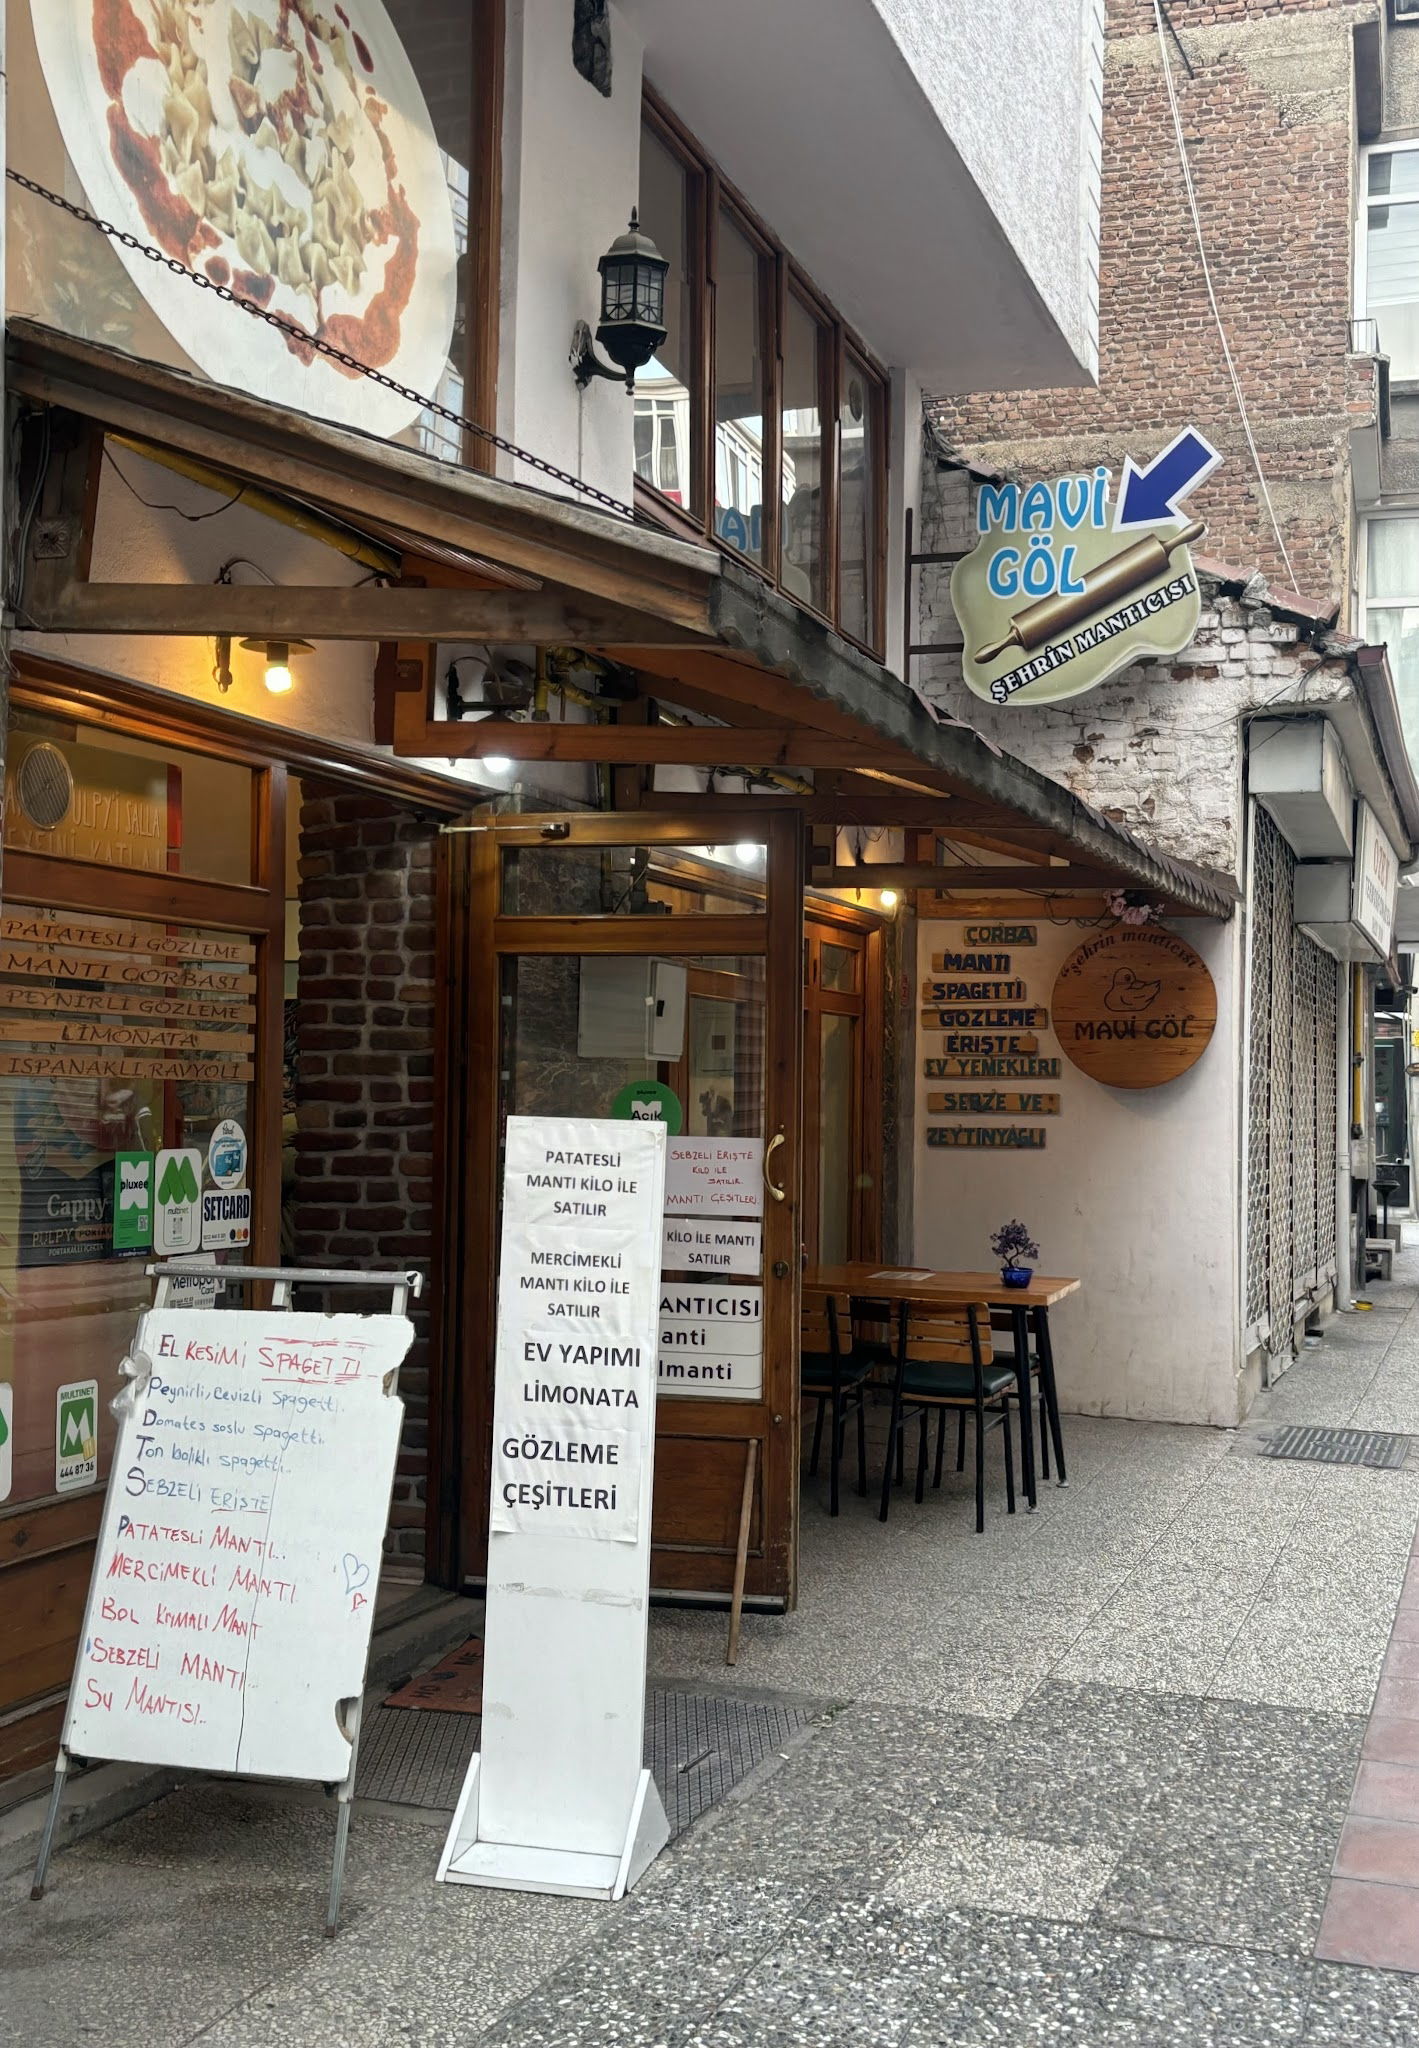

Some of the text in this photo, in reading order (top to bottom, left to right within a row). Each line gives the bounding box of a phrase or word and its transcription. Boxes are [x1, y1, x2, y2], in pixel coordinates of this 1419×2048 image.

[978, 466, 1107, 533] MAVİ
[986, 535, 1086, 598] GÖL
[990, 575, 1197, 703] ŞEHRİN MANTICISI
[7, 919, 241, 959] PATATESLİ GÖZLEME
[966, 926, 1033, 946] ÇORBA
[7, 953, 111, 979] MANTI
[944, 954, 1010, 972] MANTI
[139, 1000, 241, 1019] GÖZLEME
[1075, 1015, 1195, 1040] MAVİ GÖL
[926, 1059, 948, 1076] EV
[944, 1093, 1042, 1111] SEBZE VE
[546, 1151, 621, 1168] PATATESLİ
[120, 1179, 149, 1192] pluxee
[526, 1175, 637, 1194] MANTI KİLO İLE
[47, 1194, 107, 1222] Cappy
[204, 1195, 250, 1221] SETCARD
[553, 1201, 607, 1216] SATILIR
[666, 1194, 704, 1205] MANTI
[667, 1229, 755, 1246] KİLO İLE MANTI
[530, 1251, 622, 1269] MERCİMEKLİ
[688, 1253, 731, 1265] SATILIR
[520, 1276, 630, 1295] MANTI KİLO İLE
[547, 1303, 600, 1318] SATILIR
[660, 1297, 759, 1317] ANTICISI
[158, 1335, 179, 1357] EL
[662, 1329, 706, 1346] anti
[524, 1342, 641, 1368] EV YAPIMI
[61, 1387, 95, 1400] MULTINET
[524, 1379, 639, 1408] LİMONATA
[142, 1408, 206, 1431] Domates
[212, 1420, 245, 1434] soslu
[136, 1434, 164, 1461] Ton
[502, 1434, 619, 1465] GÖZLEME
[60, 1467, 74, 1478] 444
[74, 1464, 84, 1475] 87
[502, 1480, 617, 1511] ÇEŞİTLERİ
[229, 1565, 297, 1604] MANTI
[101, 1596, 139, 1625] BOL
